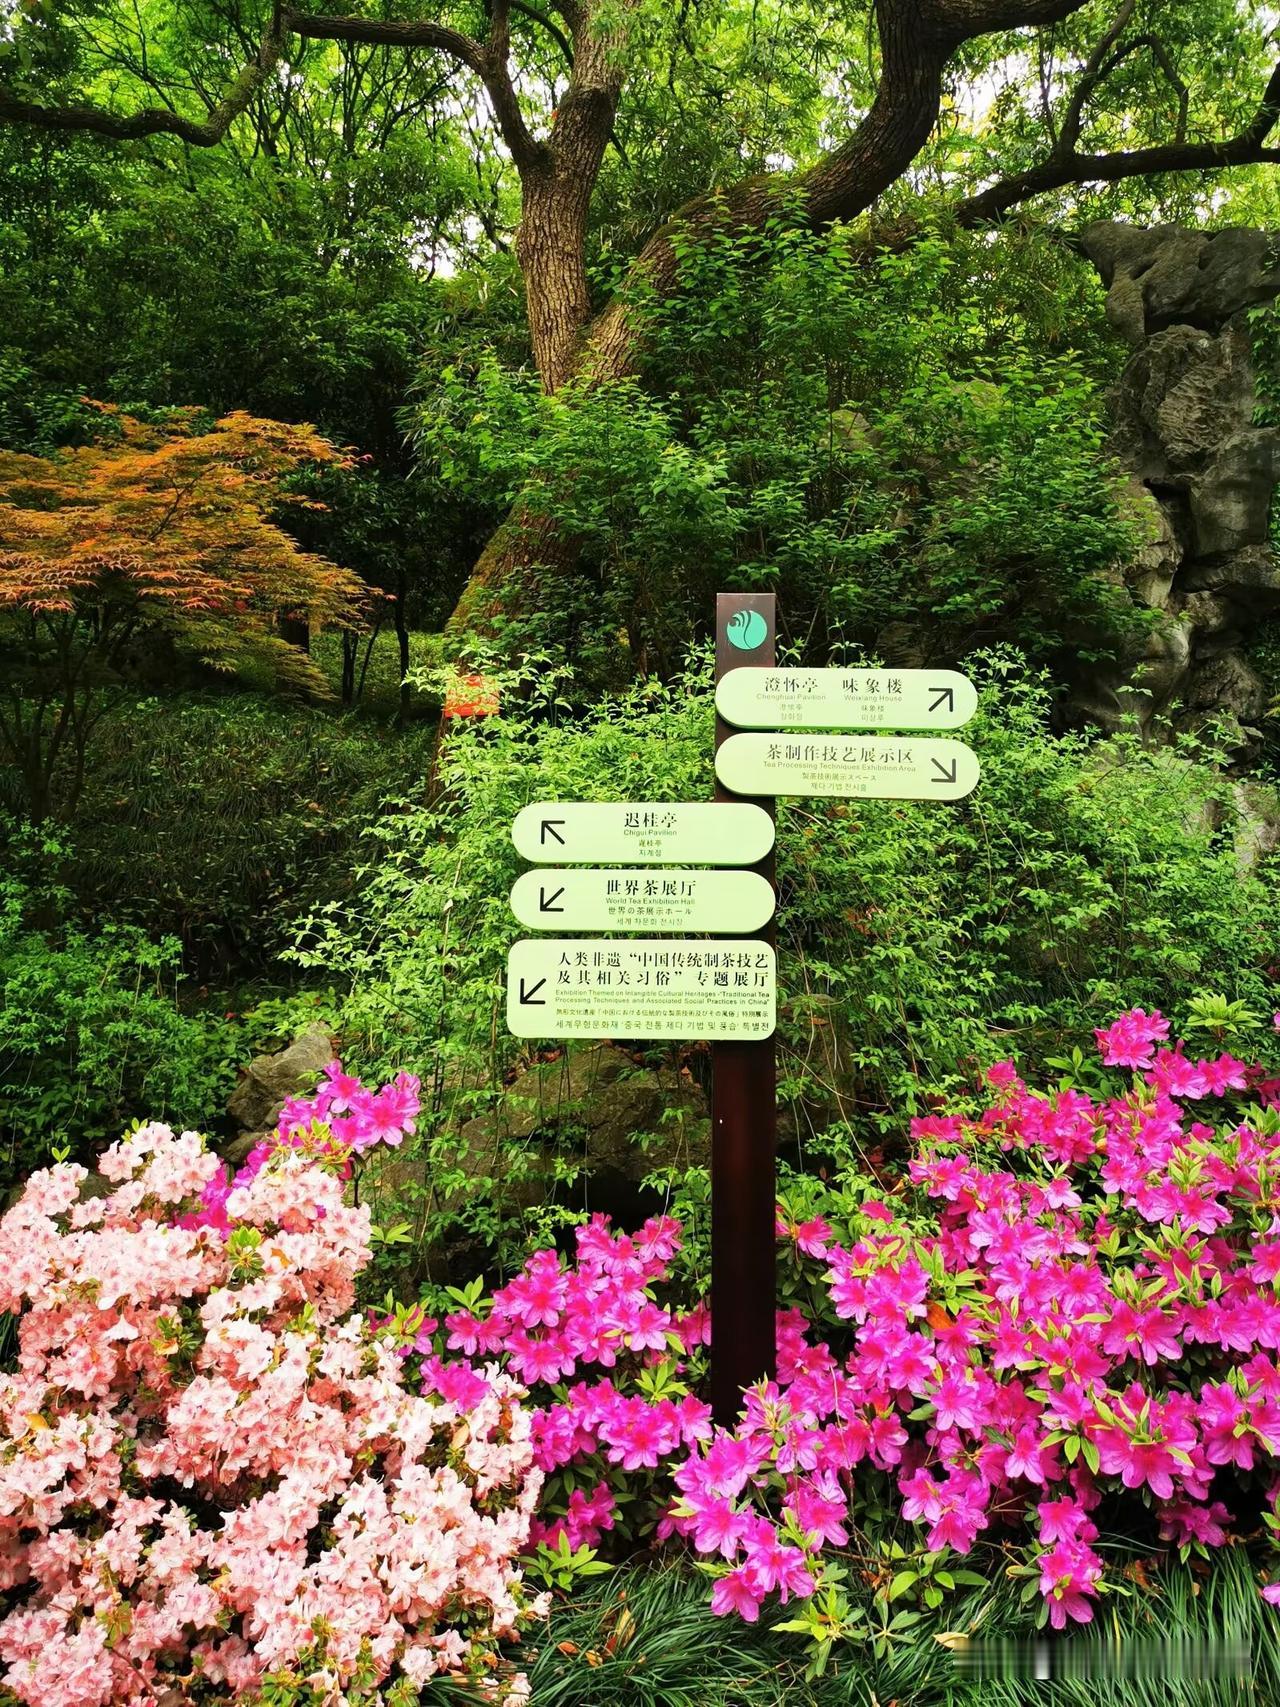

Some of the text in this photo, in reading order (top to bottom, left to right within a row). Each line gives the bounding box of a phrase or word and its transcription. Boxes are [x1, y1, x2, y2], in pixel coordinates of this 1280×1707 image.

[765, 677, 818, 692] 澄怀亭
[842, 678, 902, 694] 味象楼
[756, 692, 826, 702] Chenghuai Pavilion
[844, 694, 878, 703] Weixiang
[767, 744, 913, 764] 茶制作技艺展示区
[777, 762, 818, 771] Processing
[820, 763, 860, 772] Techniques
[862, 764, 898, 772] Exhibition
[624, 812, 677, 828] 迟桂亭
[624, 829, 647, 837] Chigui
[607, 879, 696, 896] 世界茶展厅
[606, 897, 627, 905] World
[629, 897, 641, 905] Tea
[643, 897, 679, 905] Exhibition
[608, 906, 693, 915] 世界の茶展示ホール
[555, 989, 587, 997] Exhibition
[588, 989, 615, 997] Themed
[625, 990, 657, 998] Intangible
[658, 990, 683, 998] Cultural
[685, 991, 716, 999] Heritages
[555, 997, 591, 1005] Processing
[594, 997, 630, 1005] Techniques
[707, 998, 738, 1006] Practices
